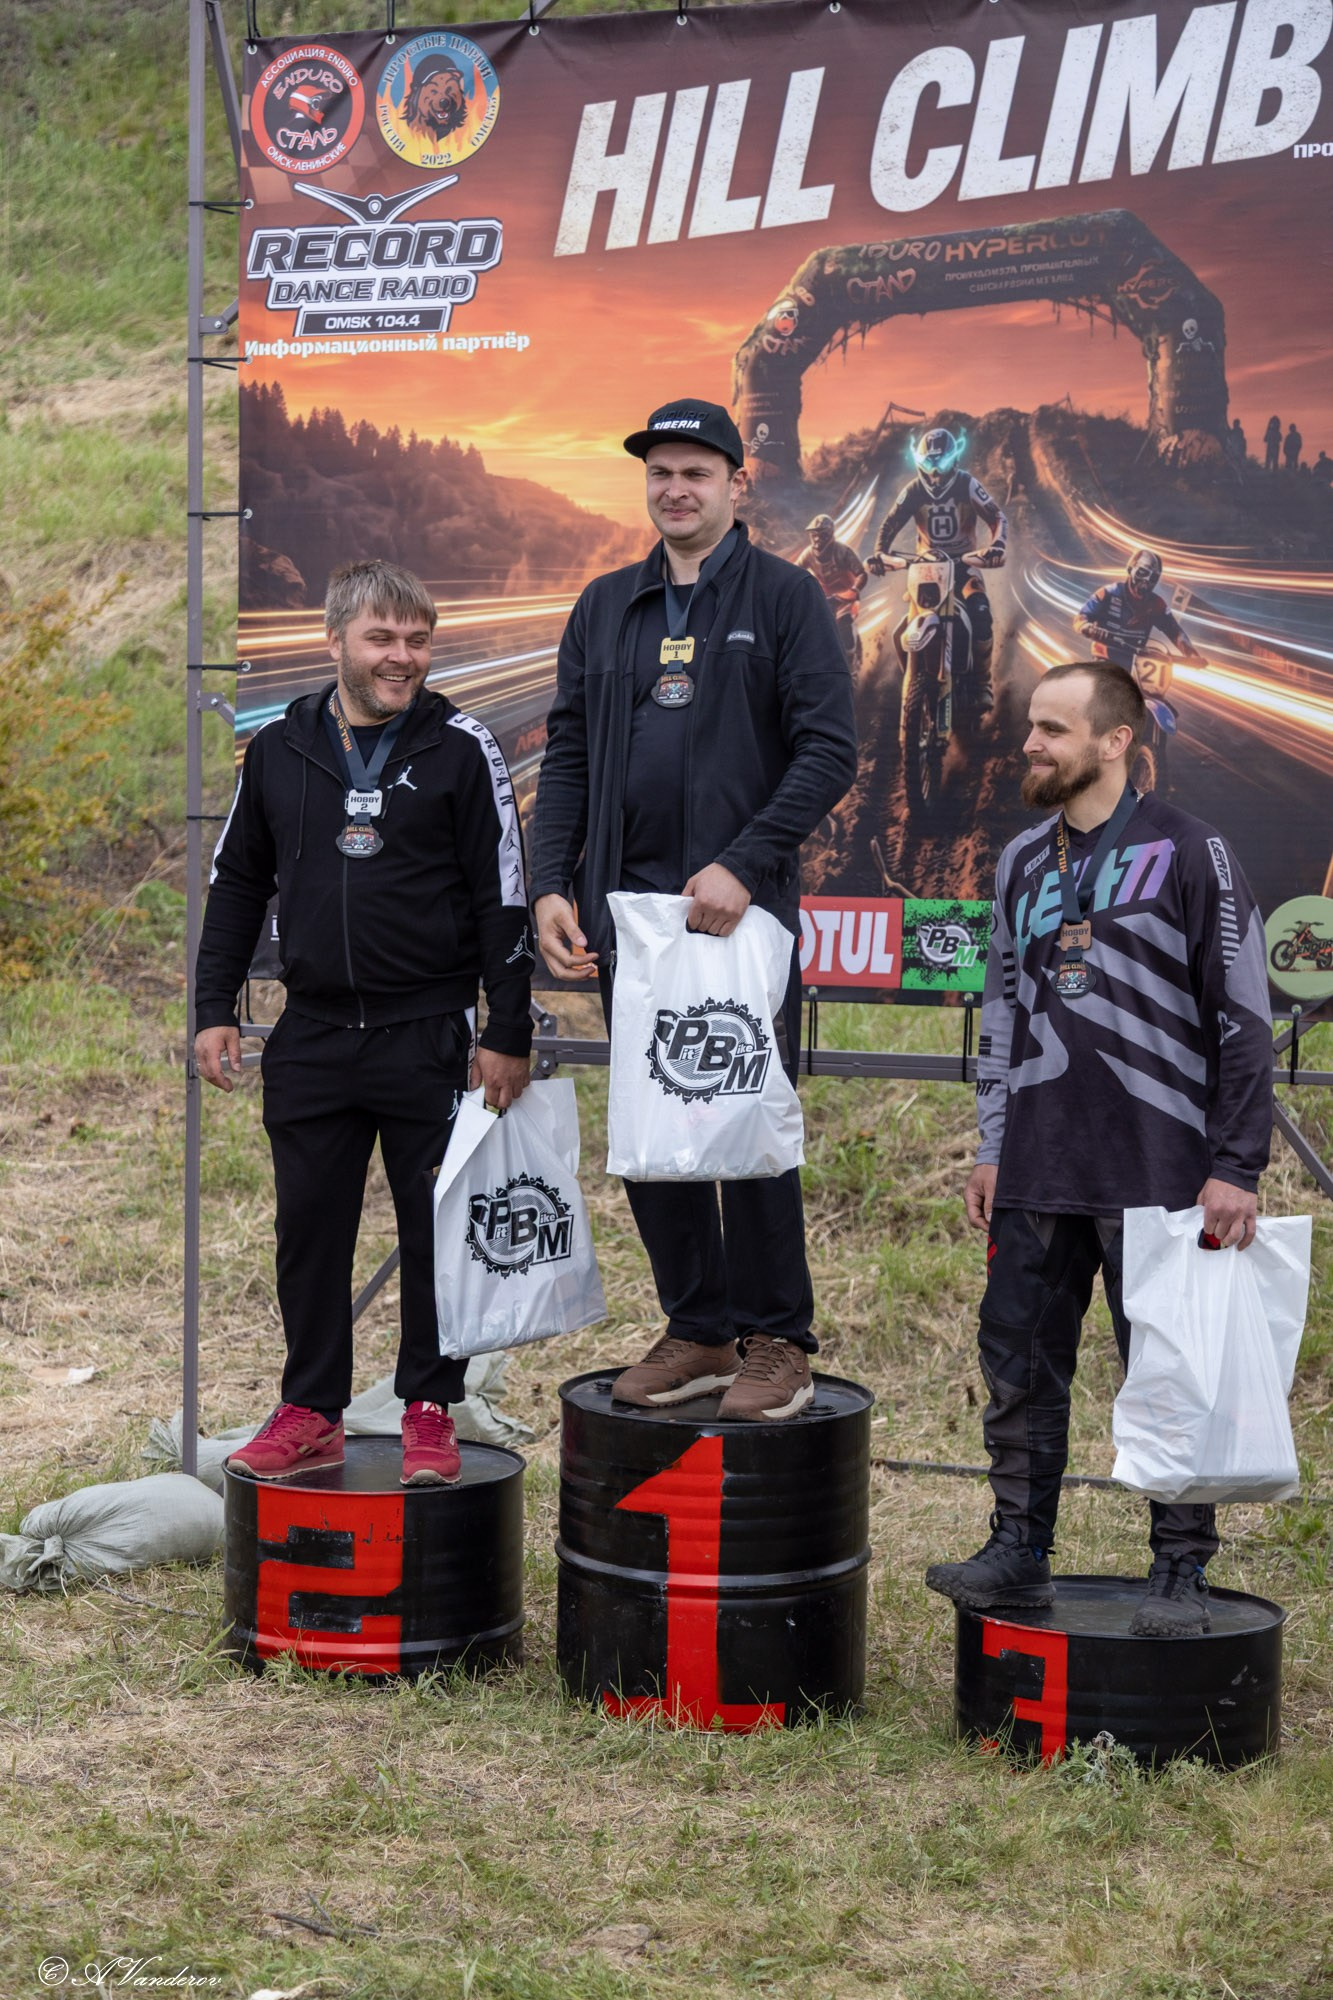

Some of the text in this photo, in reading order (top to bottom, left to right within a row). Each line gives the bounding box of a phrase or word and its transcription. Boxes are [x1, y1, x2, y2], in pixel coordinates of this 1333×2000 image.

[383, 34, 494, 84] ПРОСТЫЕ ПАРНИ
[273, 68, 344, 100] ENDURO
[378, 104, 406, 152] РОССИЯ
[553, 0, 1333, 257] HILL CLIMB
[421, 152, 452, 165] 2022
[1294, 142, 1333, 158] ПРО
[249, 225, 501, 275] RECORD
[275, 276, 472, 303] DANCE RADIO
[325, 314, 420, 330] OMSK 104.4
[244, 331, 530, 358] Информационный партнёр
[653, 420, 701, 430] SIBERIA
[663, 643, 692, 651] HOBBY
[1140, 660, 1167, 687] 21
[454, 716, 514, 807] JORDAN
[361, 803, 368, 811] 2
[1026, 850, 1048, 875] LEATT
[1057, 847, 1068, 874] HILL
[1210, 840, 1230, 888] LEATT
[799, 908, 894, 974] OTUL
[1062, 928, 1089, 937] HOBBY
[1072, 936, 1079, 945] 3
[927, 928, 978, 966] PBM
[681, 1048, 696, 1060] it
[737, 1043, 755, 1055] ike
[540, 1213, 556, 1224] ike
[496, 1227, 508, 1239] it
[257, 1484, 404, 1673] 2
[603, 1435, 786, 1735] 1
